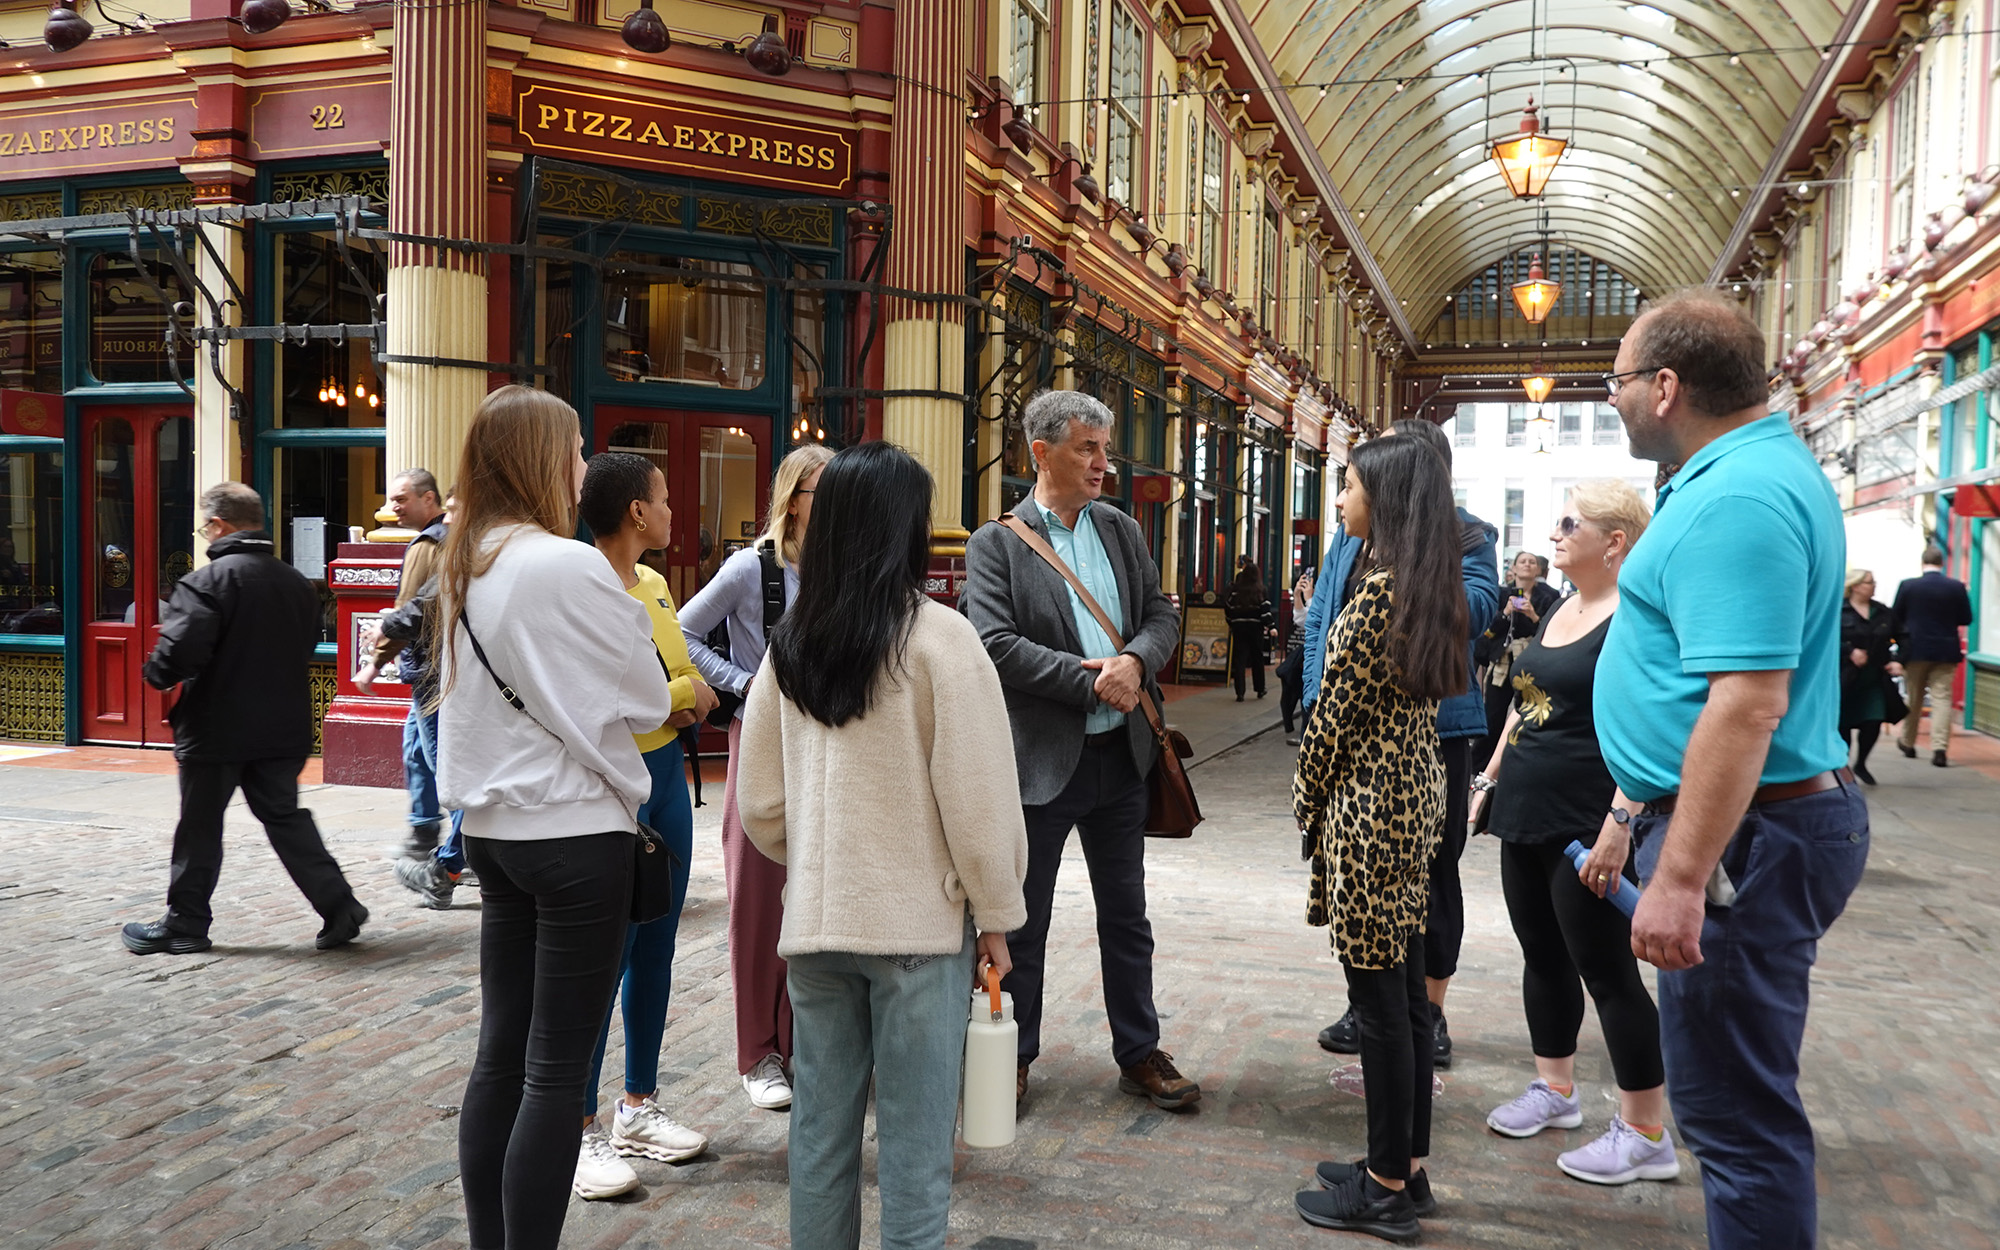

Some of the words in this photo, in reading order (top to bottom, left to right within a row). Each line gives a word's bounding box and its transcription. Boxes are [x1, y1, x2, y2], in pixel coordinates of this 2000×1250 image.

[0, 117, 175, 157] ZAEXPRESS
[312, 104, 345, 130] 22
[538, 103, 836, 171] PIZZAEXPRESS
